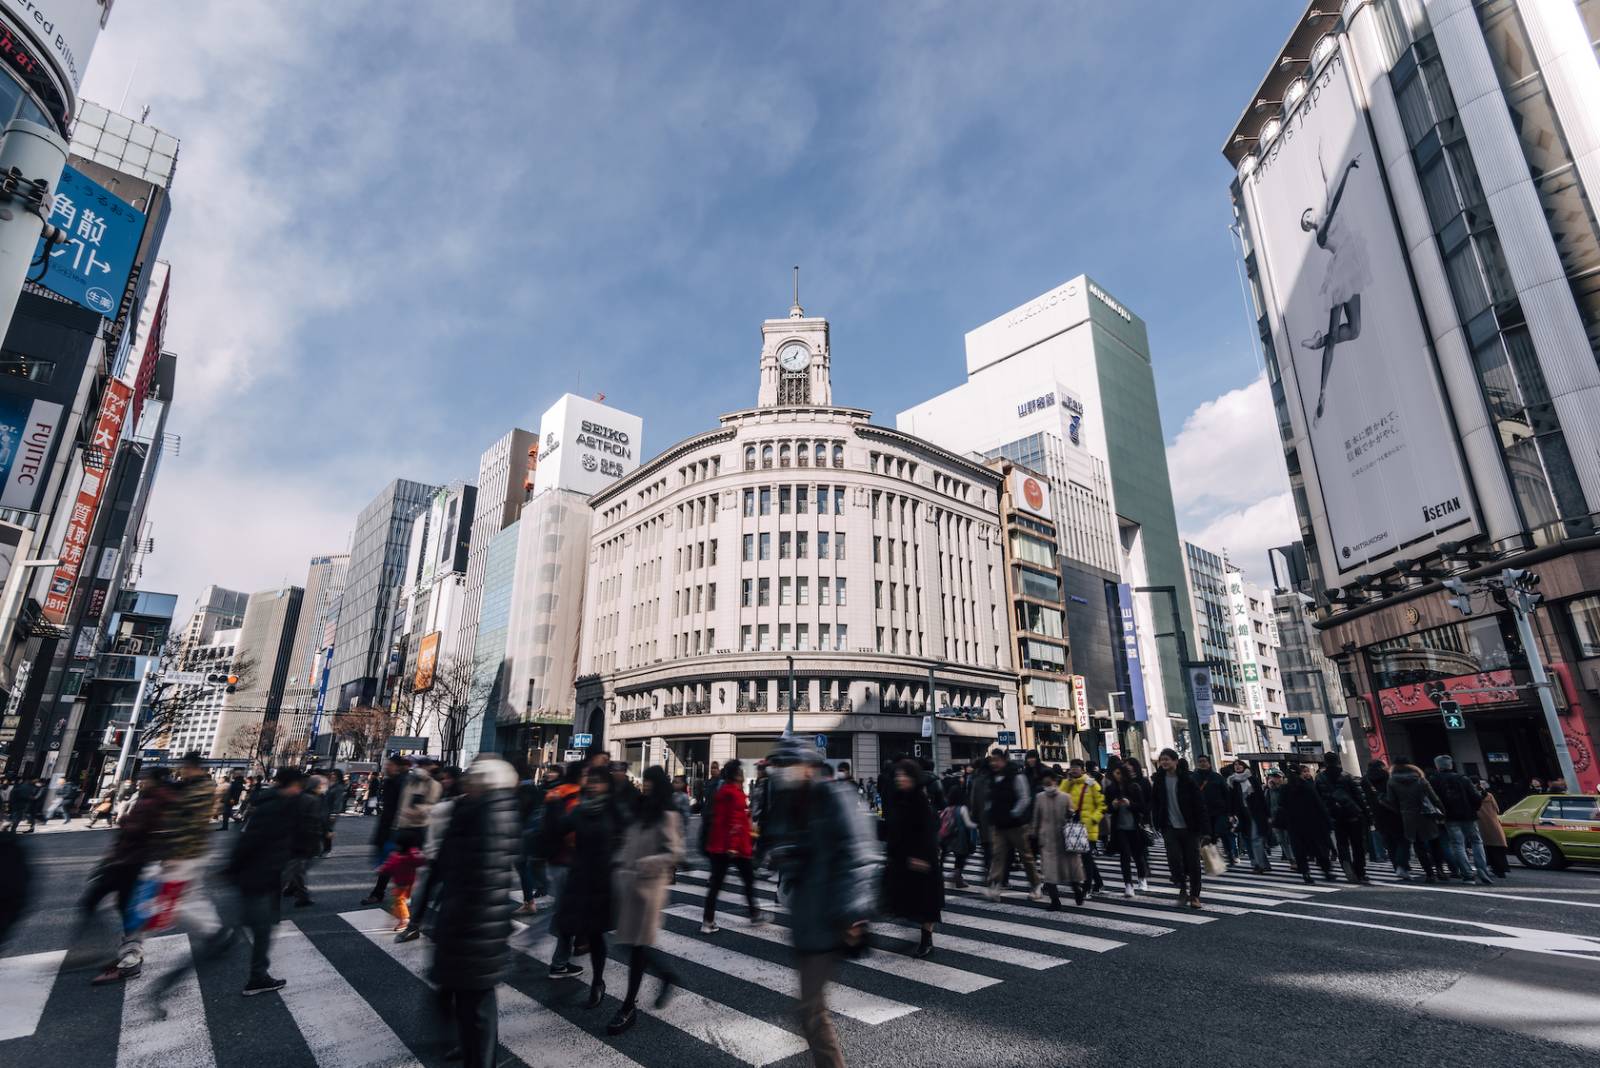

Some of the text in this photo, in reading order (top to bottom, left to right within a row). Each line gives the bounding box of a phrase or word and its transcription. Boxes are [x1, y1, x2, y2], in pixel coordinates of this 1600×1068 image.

[48, 193, 107, 247] 角散
[575, 433, 632, 460] ASTRON
[581, 420, 629, 446] SEIKO
[17, 422, 52, 487] FUJITEC
[1352, 530, 1389, 552] MITSUKOSHI
